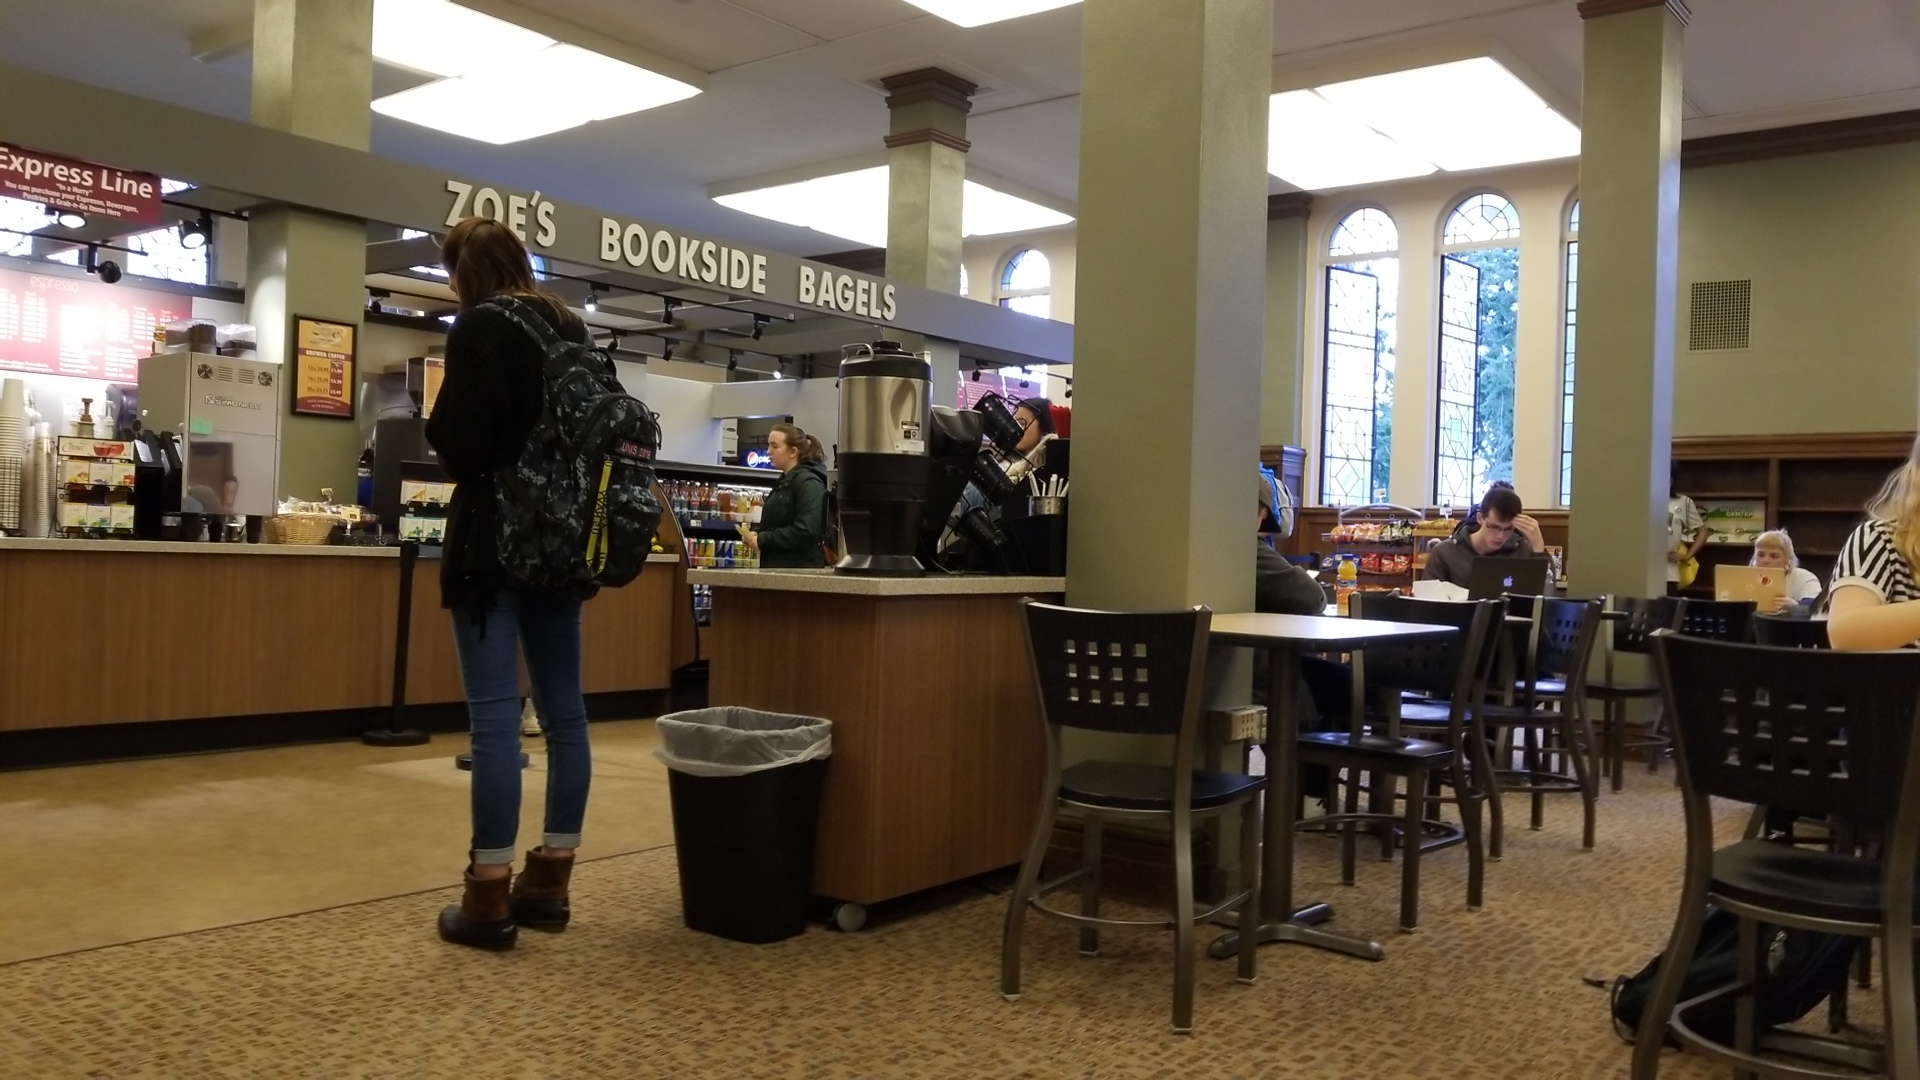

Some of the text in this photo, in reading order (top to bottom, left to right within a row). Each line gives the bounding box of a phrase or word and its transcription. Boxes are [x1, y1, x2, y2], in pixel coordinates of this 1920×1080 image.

[4, 180, 17, 189] You
[31, 187, 60, 198] purchase
[61, 192, 76, 200] your
[101, 169, 153, 199] Line
[22, 191, 48, 203] Pastries
[106, 208, 121, 217] Here
[444, 180, 896, 321] ZOE'S BOOKSIDE BAGELS
[30, 276, 79, 292] espresso
[758, 456, 771, 464] pep
